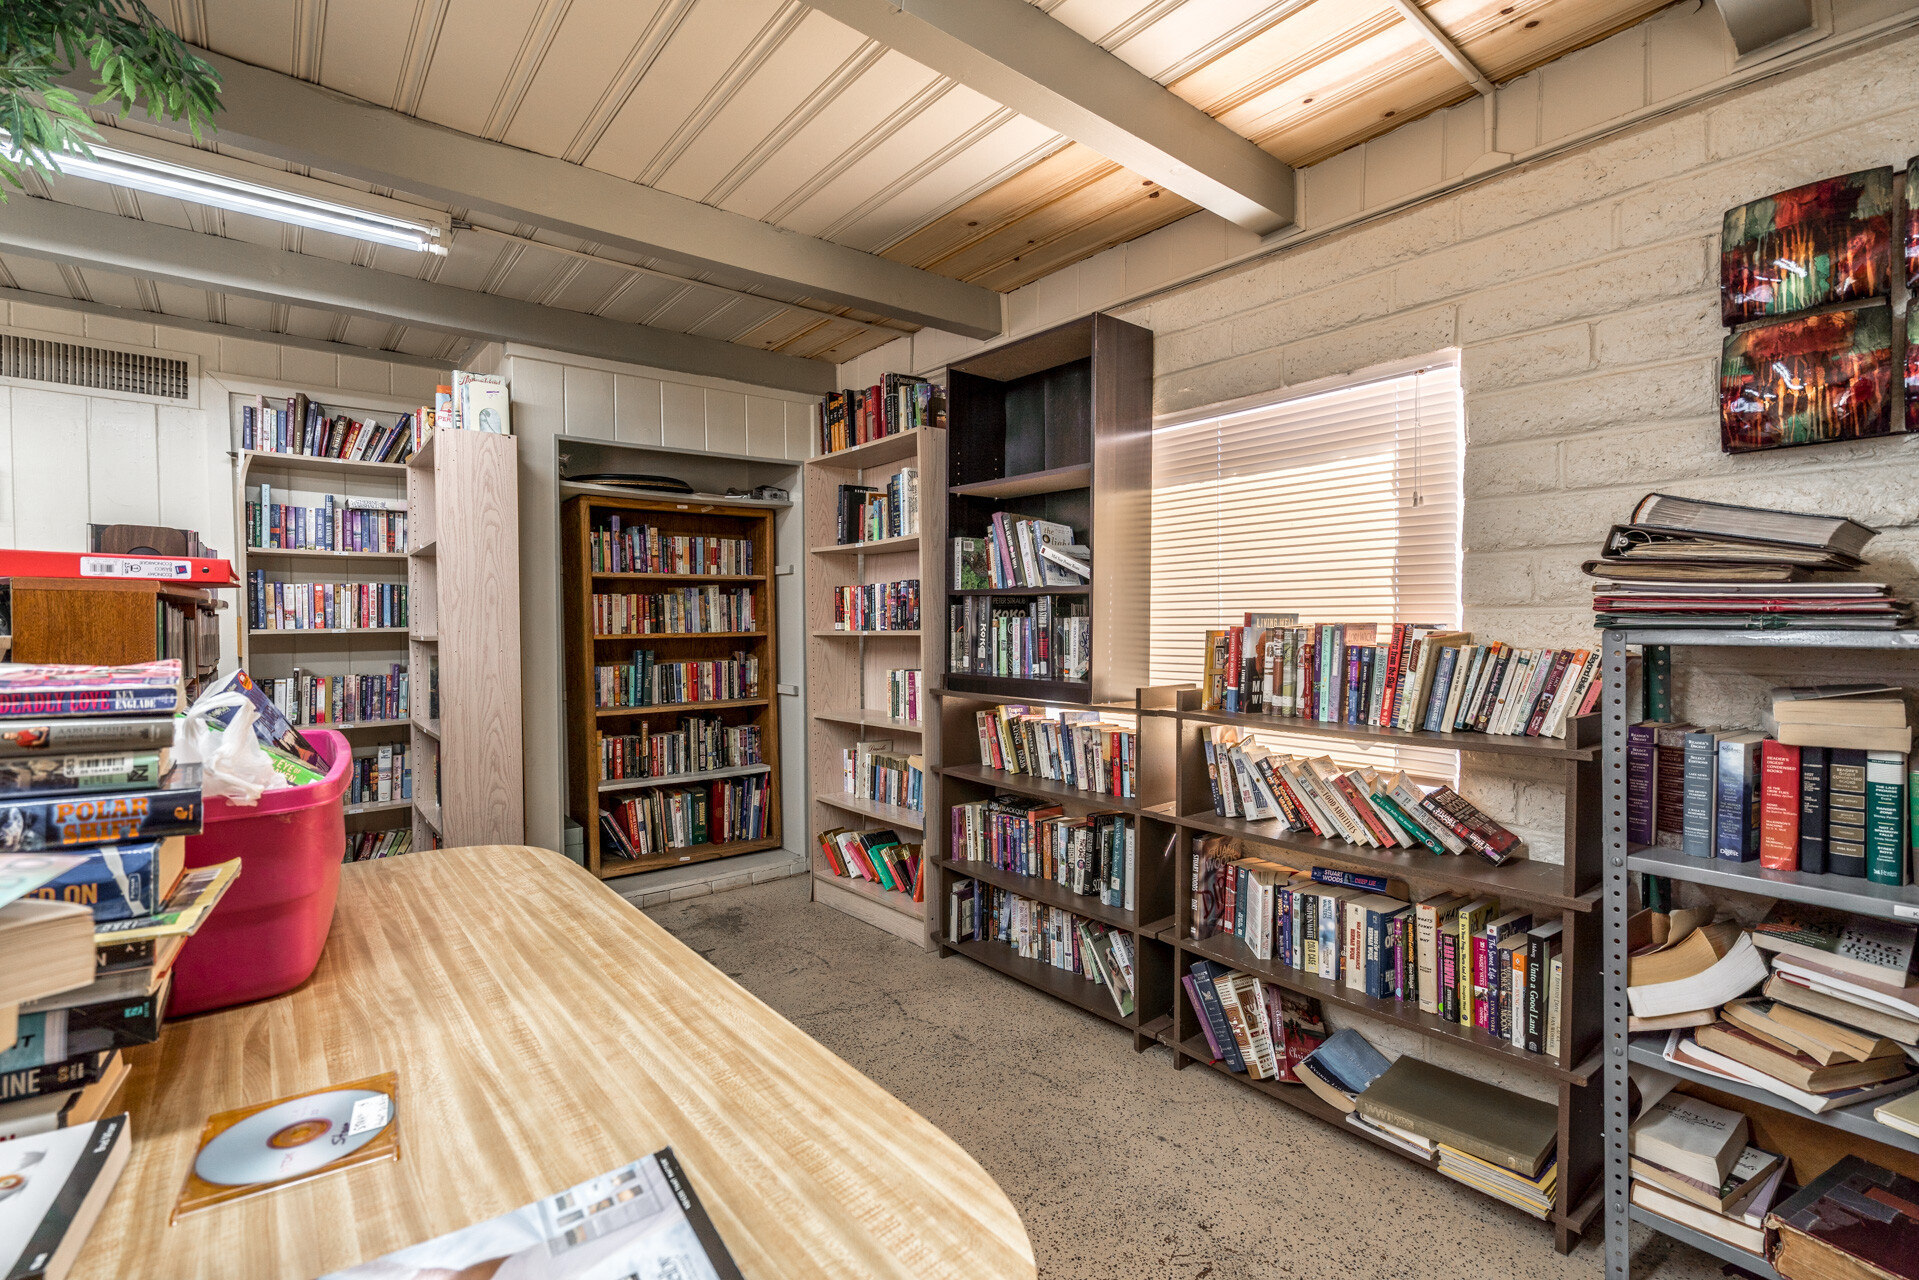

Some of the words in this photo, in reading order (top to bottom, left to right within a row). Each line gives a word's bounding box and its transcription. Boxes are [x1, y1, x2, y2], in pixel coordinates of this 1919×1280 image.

[1256, 618, 1278, 628] LIVING
[1392, 628, 1402, 650] Hunters
[1584, 653, 1600, 678] Beyond
[1385, 676, 1396, 688] Sky
[1576, 676, 1588, 695] Belief
[0, 692, 65, 714] DEADLY
[70, 690, 110, 711] LOVE
[115, 690, 134, 700] KEN
[115, 699, 156, 710] ENGLADE
[96, 726, 132, 734] FISHER
[1013, 726, 1022, 745] KING
[276, 759, 294, 773] EYE
[292, 768, 302, 776] OF
[1279, 786, 1294, 810] BONFIRE
[56, 797, 149, 824] POLAR
[1278, 797, 1296, 822] VANITIES
[1322, 791, 1336, 808] FOOD
[1334, 805, 1357, 834] ADDITIVES
[62, 818, 141, 844] SHIFT
[1208, 845, 1236, 860] STUART
[1322, 875, 1344, 884] WOODS
[1324, 869, 1344, 878] STUART
[64, 883, 98, 904] ON
[1306, 903, 1314, 922] STEPHEN
[1306, 922, 1314, 940] WHITE
[1307, 941, 1316, 953] COLD
[1444, 946, 1454, 960] BAD
[1851, 944, 1898, 960] John
[1308, 953, 1316, 966] CASE
[1488, 950, 1496, 966] Sweet
[1444, 960, 1454, 988] COMPANY
[1488, 967, 1497, 980] Life
[1530, 962, 1538, 982] Unto
[1530, 990, 1538, 1012] Good
[1529, 1013, 1538, 1035] Land
